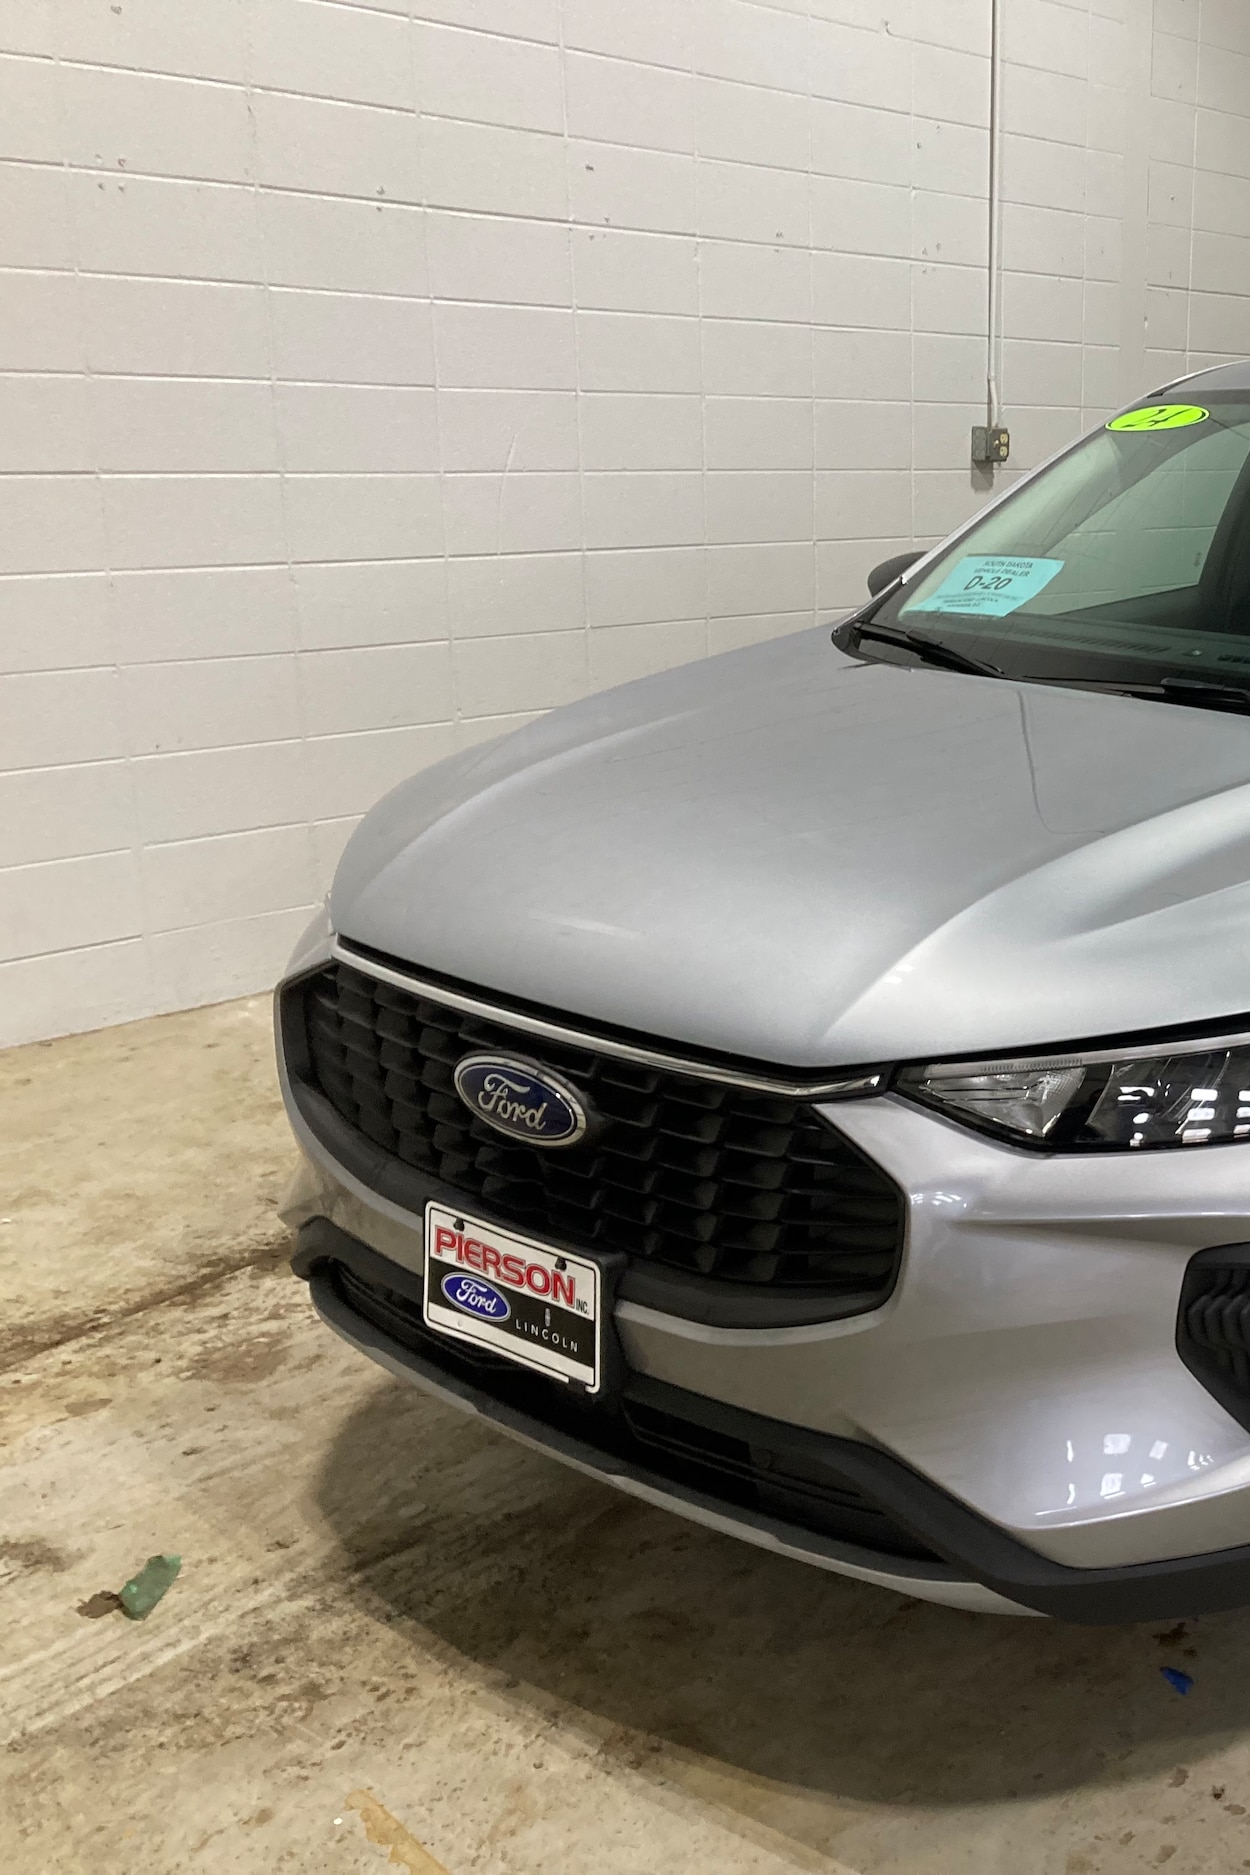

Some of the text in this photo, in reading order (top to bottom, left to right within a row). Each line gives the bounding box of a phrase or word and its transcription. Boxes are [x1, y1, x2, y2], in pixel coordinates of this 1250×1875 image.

[1006, 561, 1034, 569] DAKOTA
[963, 575, 1013, 591] D-20
[478, 1073, 548, 1130] Ford
[434, 1225, 590, 1316] PIERSON INC.
[456, 1279, 498, 1314] Ford
[515, 1318, 578, 1353] LINCOLN
